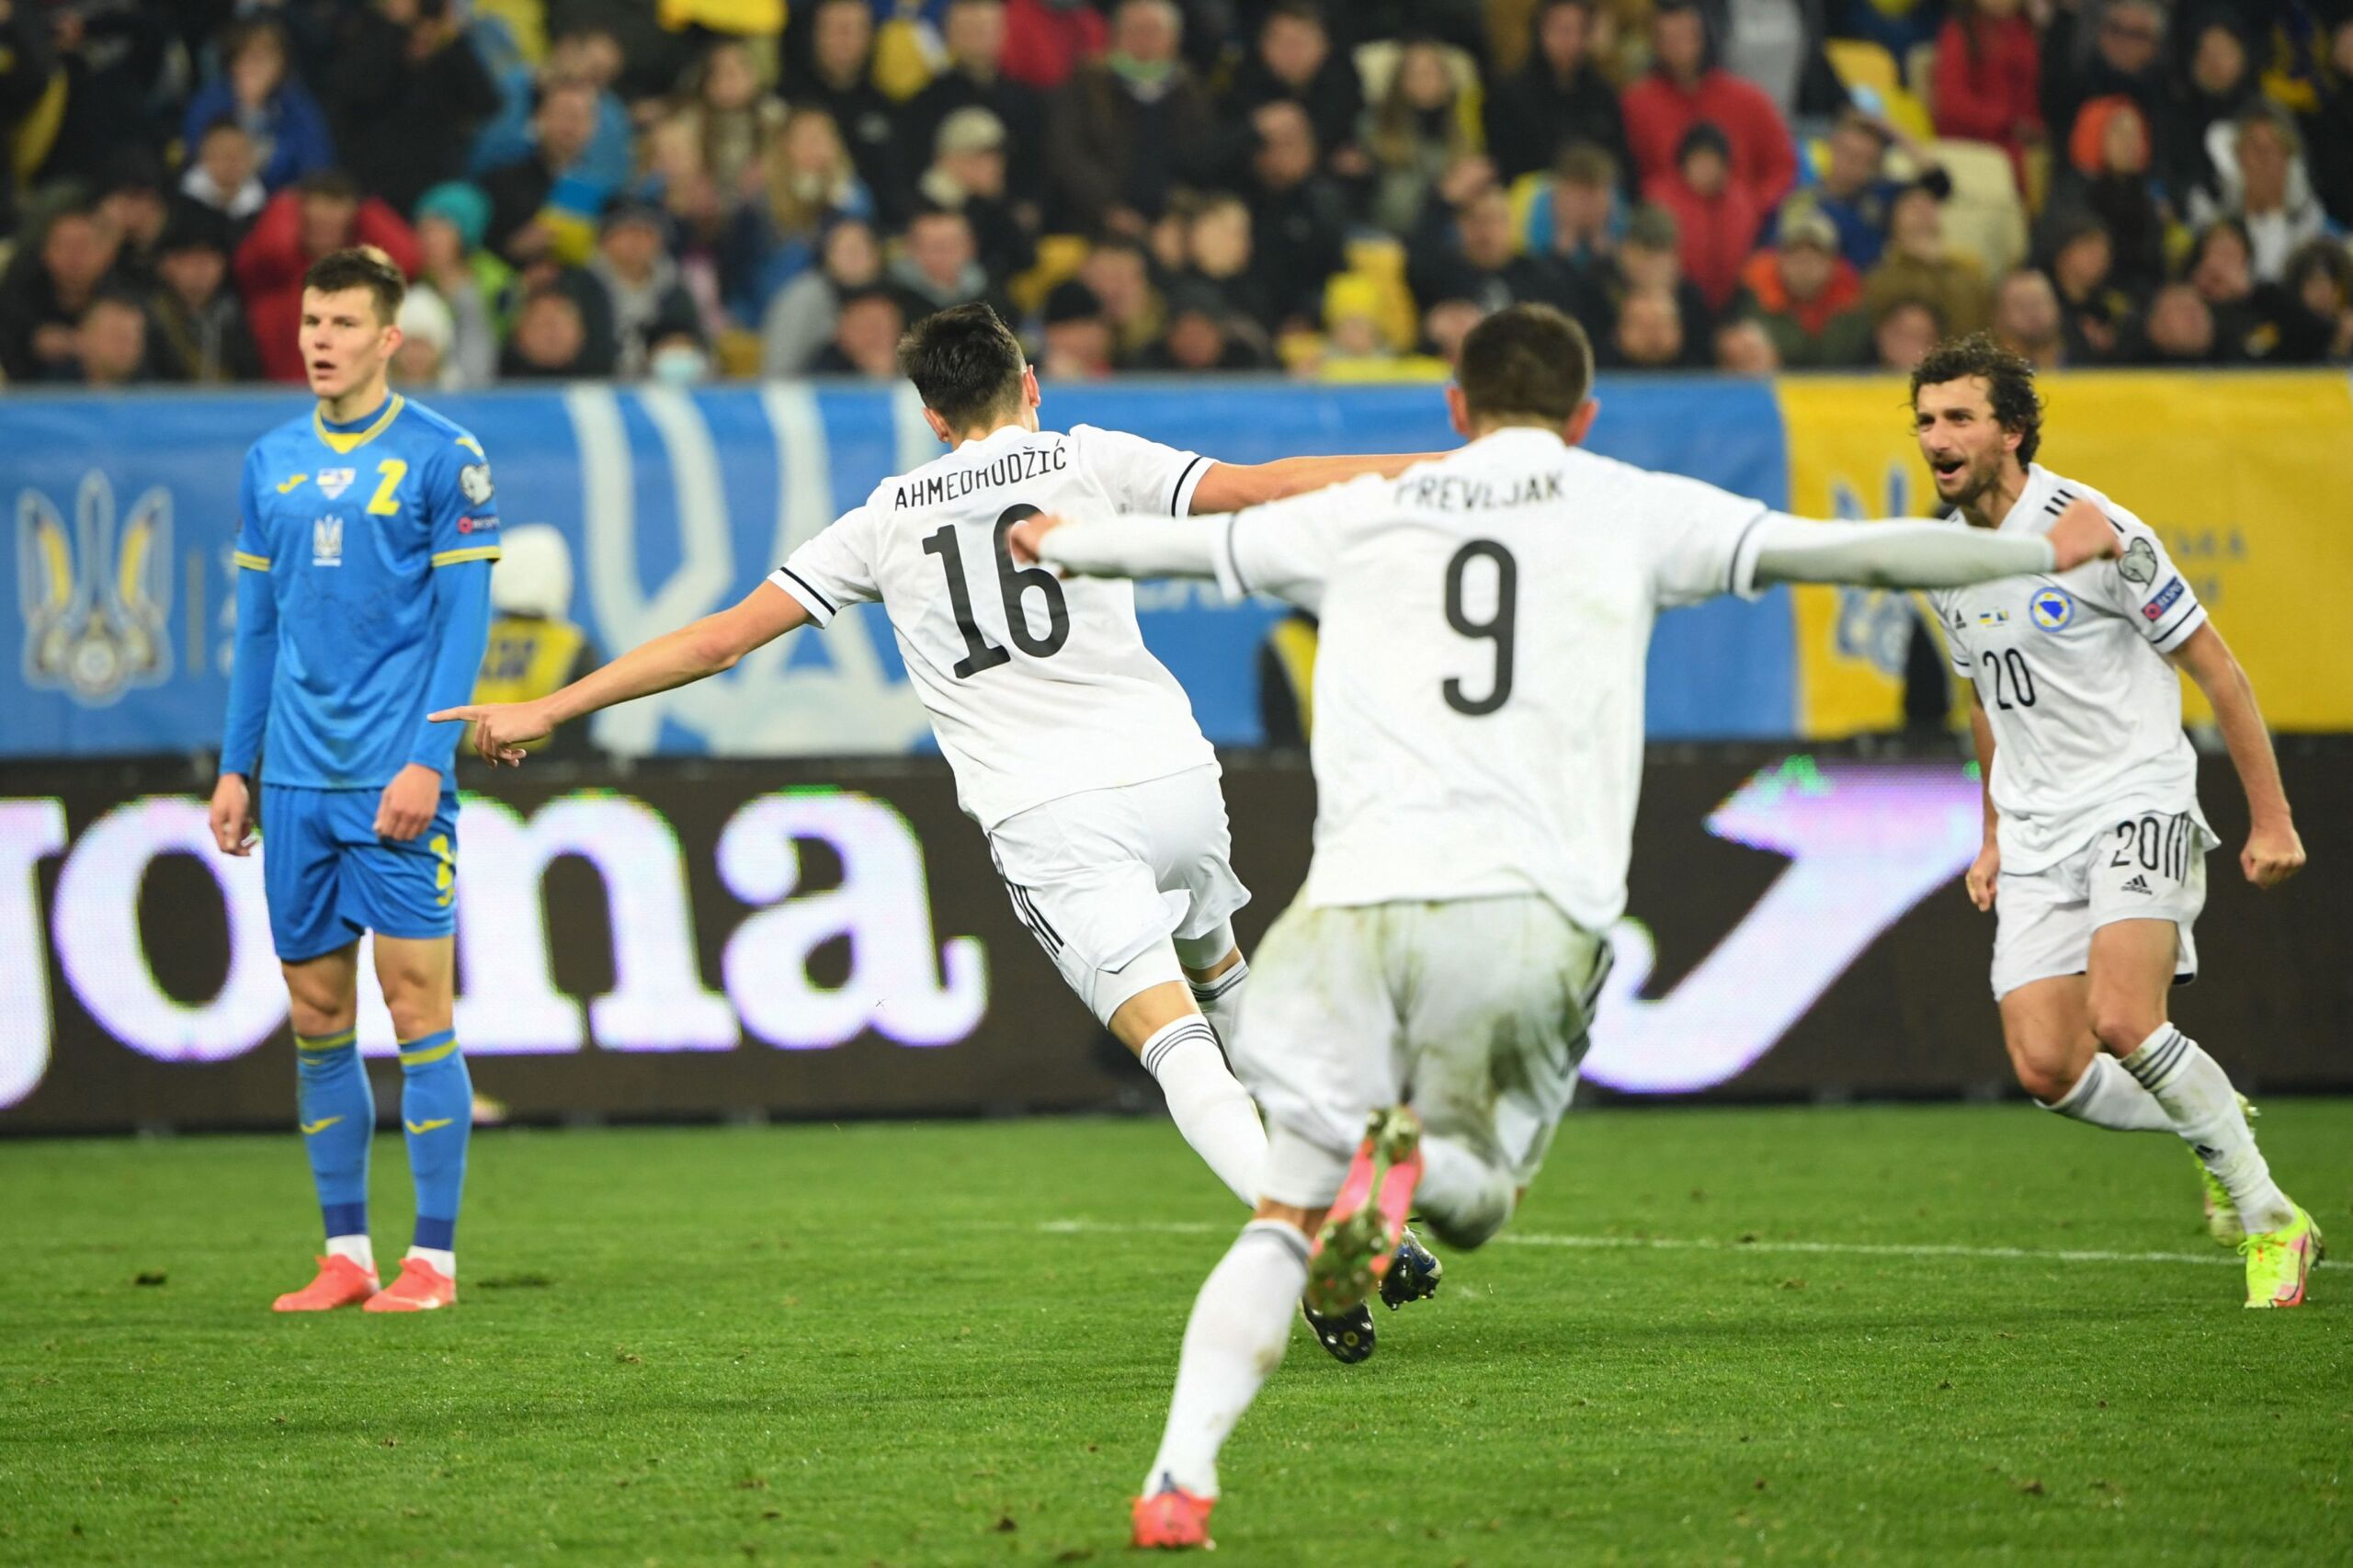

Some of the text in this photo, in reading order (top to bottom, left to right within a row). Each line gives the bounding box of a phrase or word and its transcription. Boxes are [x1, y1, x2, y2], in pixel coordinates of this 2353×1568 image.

[366, 459, 407, 516] 2
[922, 503, 1070, 679] 16
[1442, 539, 1517, 716] 9
[1983, 647, 2036, 710] 20
[2110, 815, 2159, 871] 20
